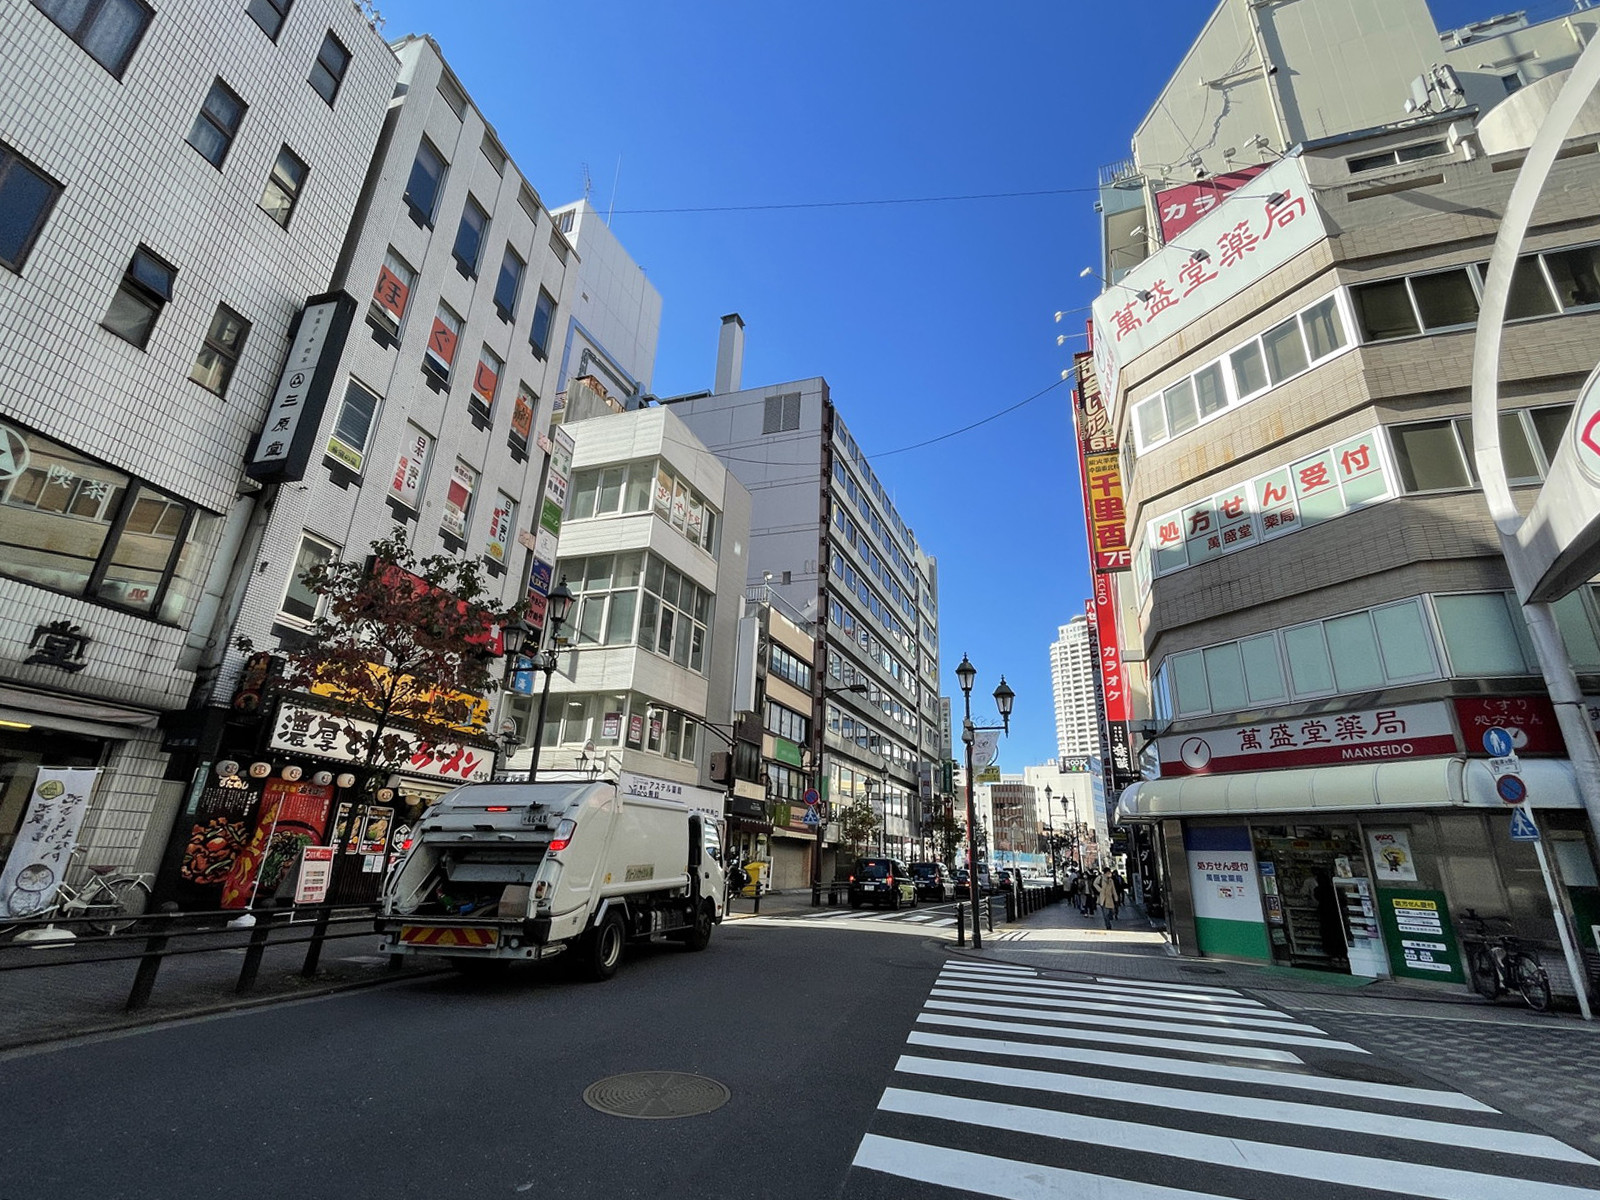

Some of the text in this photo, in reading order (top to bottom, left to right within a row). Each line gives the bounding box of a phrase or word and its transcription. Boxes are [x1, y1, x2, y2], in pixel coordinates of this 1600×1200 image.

[1164, 187, 1240, 222] カラ
[1109, 189, 1306, 342] 萬盛堂薬局
[264, 394, 299, 458] 三原堂
[50, 463, 110, 502] 喫茶
[1159, 443, 1370, 546] 処方せん受付
[1091, 472, 1127, 549] 千里香
[1207, 508, 1295, 551] 萬盛堂薬局
[1104, 551, 1131, 566] 7F
[23, 620, 92, 673] 堂
[1103, 646, 1121, 702] カラオケ
[1475, 714, 1543, 726] 処方せん
[1483, 699, 1527, 710] くすり
[1237, 710, 1407, 752] 萬盛堂薬局
[1341, 743, 1414, 760] MANSEIDO
[1141, 850, 1152, 890] ダーツ
[1197, 861, 1249, 871] 処方せん受付
